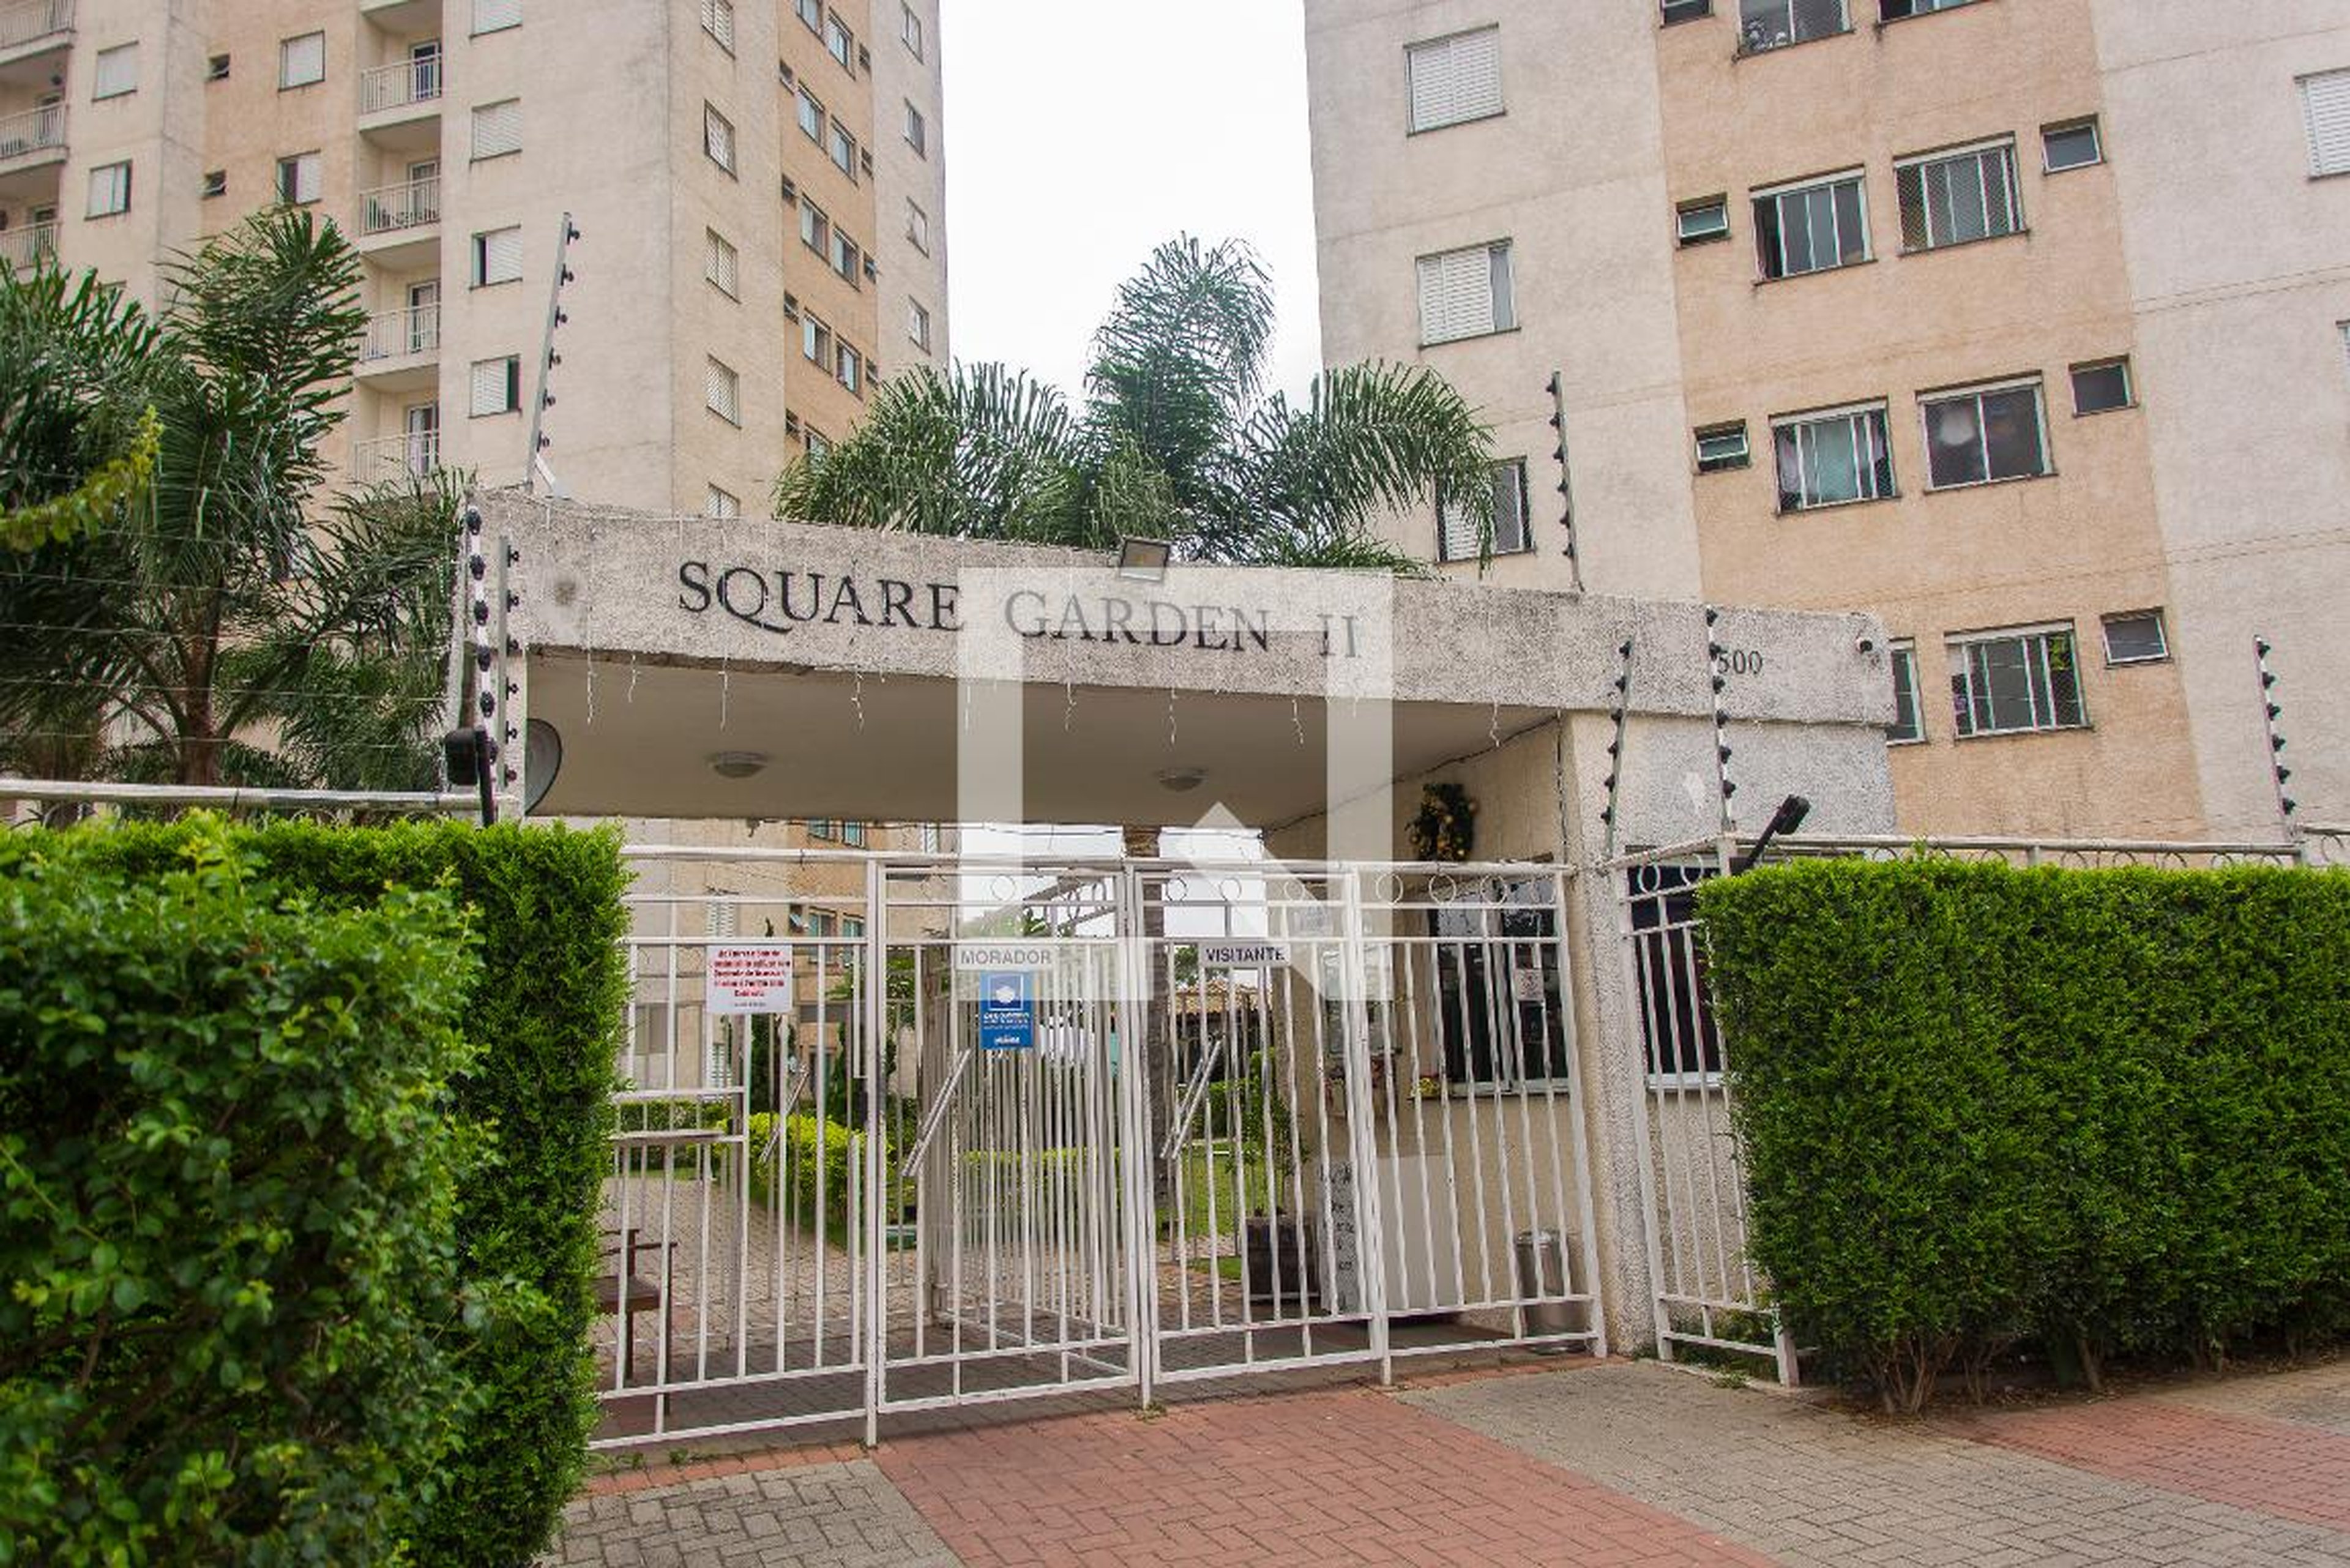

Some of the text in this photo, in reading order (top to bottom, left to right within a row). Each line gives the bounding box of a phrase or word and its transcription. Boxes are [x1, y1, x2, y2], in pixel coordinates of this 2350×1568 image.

[679, 561, 1362, 659] SQUARE GARDEN II
[1716, 648, 1763, 674] 500
[961, 950, 1051, 965] MORADOR
[1205, 946, 1285, 962] VISITANTE
